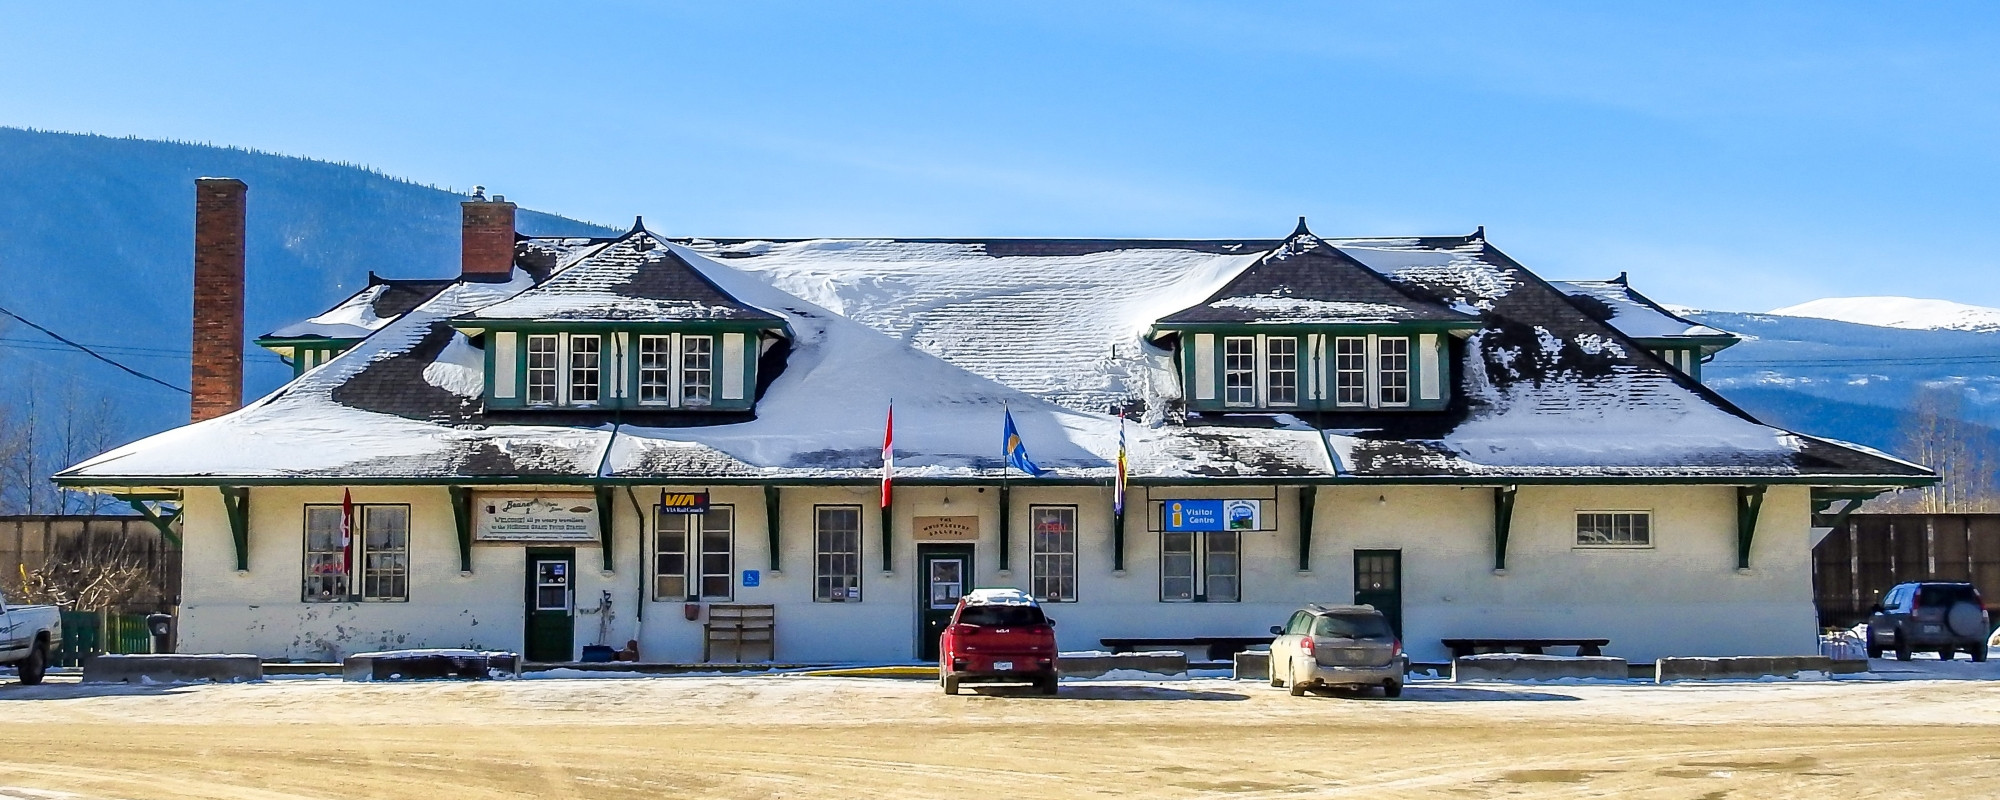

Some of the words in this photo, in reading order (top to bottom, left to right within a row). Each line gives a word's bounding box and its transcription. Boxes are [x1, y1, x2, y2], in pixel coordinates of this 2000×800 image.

[666, 495, 694, 505] VIA
[502, 501, 535, 512] Beaner
[1186, 508, 1213, 516] Visitor
[1189, 516, 1215, 524] Centre
[923, 523, 970, 531] WHISTLESTOP
[1037, 523, 1067, 533] OPEN
